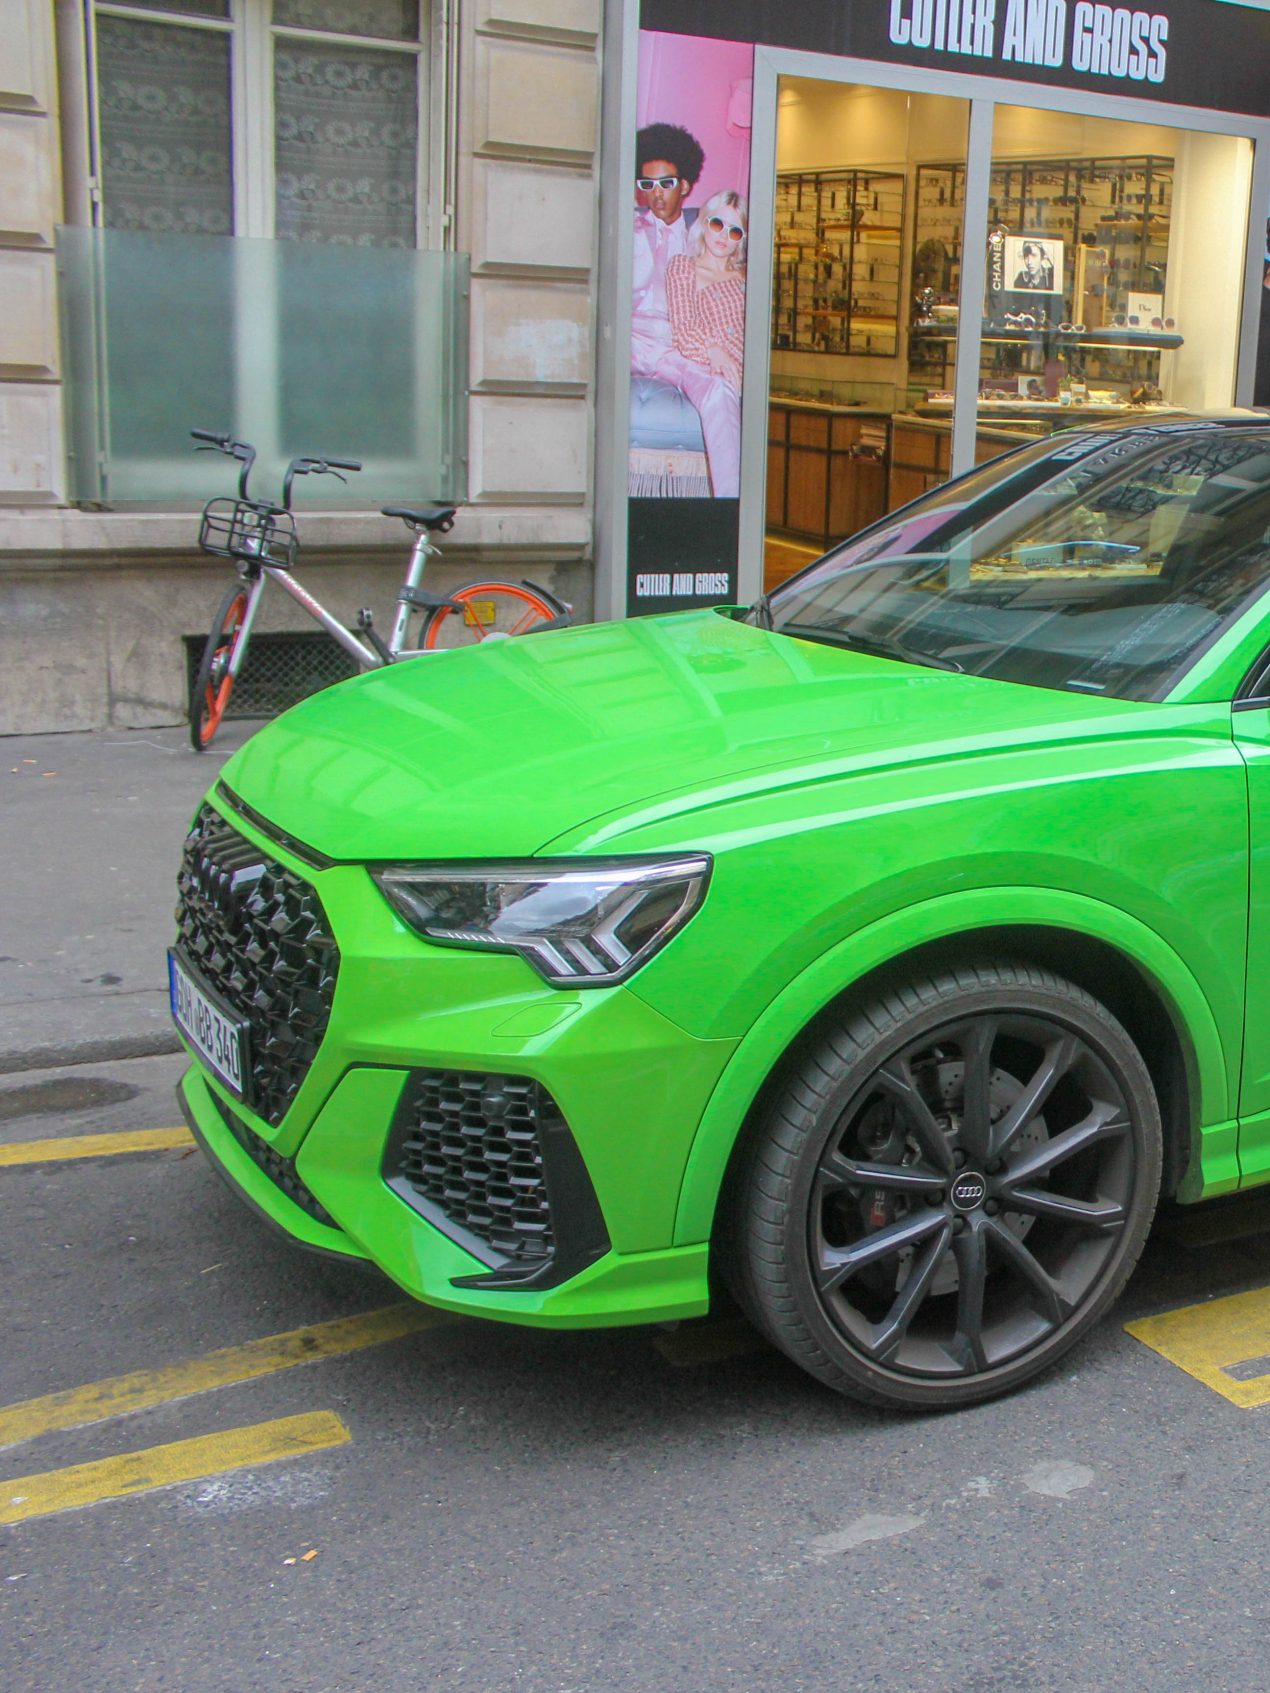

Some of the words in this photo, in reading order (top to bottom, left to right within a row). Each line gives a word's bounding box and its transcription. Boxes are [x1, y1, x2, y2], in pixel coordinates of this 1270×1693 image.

[889, 0, 996, 58] CUTLER
[1001, 0, 1067, 68] AND
[1071, 0, 1169, 83] GROSS
[992, 241, 1002, 291] CHANE
[636, 573, 671, 597] CUTLER
[672, 572, 694, 596] AND
[695, 571, 729, 595] GROSS
[213, 1013, 241, 1082] 340
